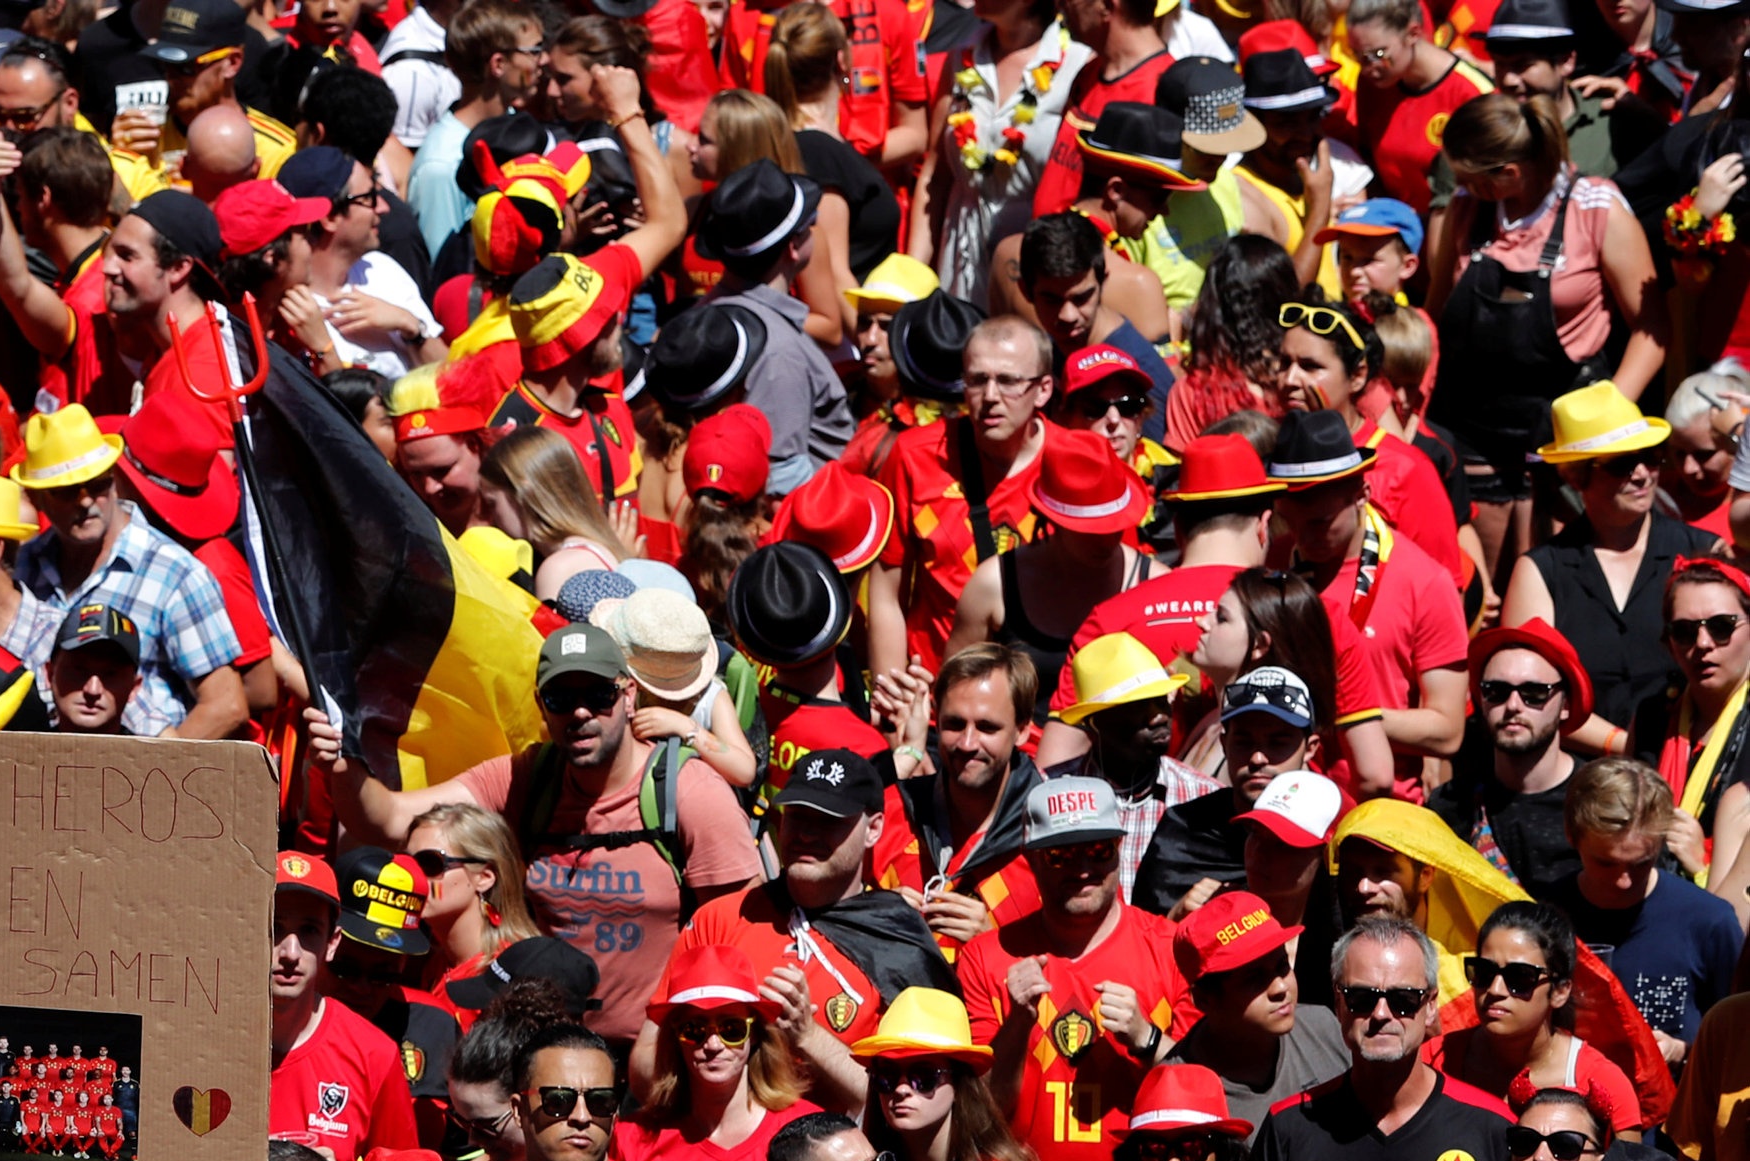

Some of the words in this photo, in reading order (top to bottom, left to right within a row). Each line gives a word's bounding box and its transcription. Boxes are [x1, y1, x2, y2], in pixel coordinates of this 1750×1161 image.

[13, 763, 227, 844] HEROS
[1047, 791, 1098, 817] DESPE
[525, 857, 645, 896] Surfin
[592, 921, 647, 955] 89
[1215, 907, 1272, 947] BELGIUM
[16, 947, 222, 1016] SAMEN
[307, 1112, 350, 1135] Belgium
